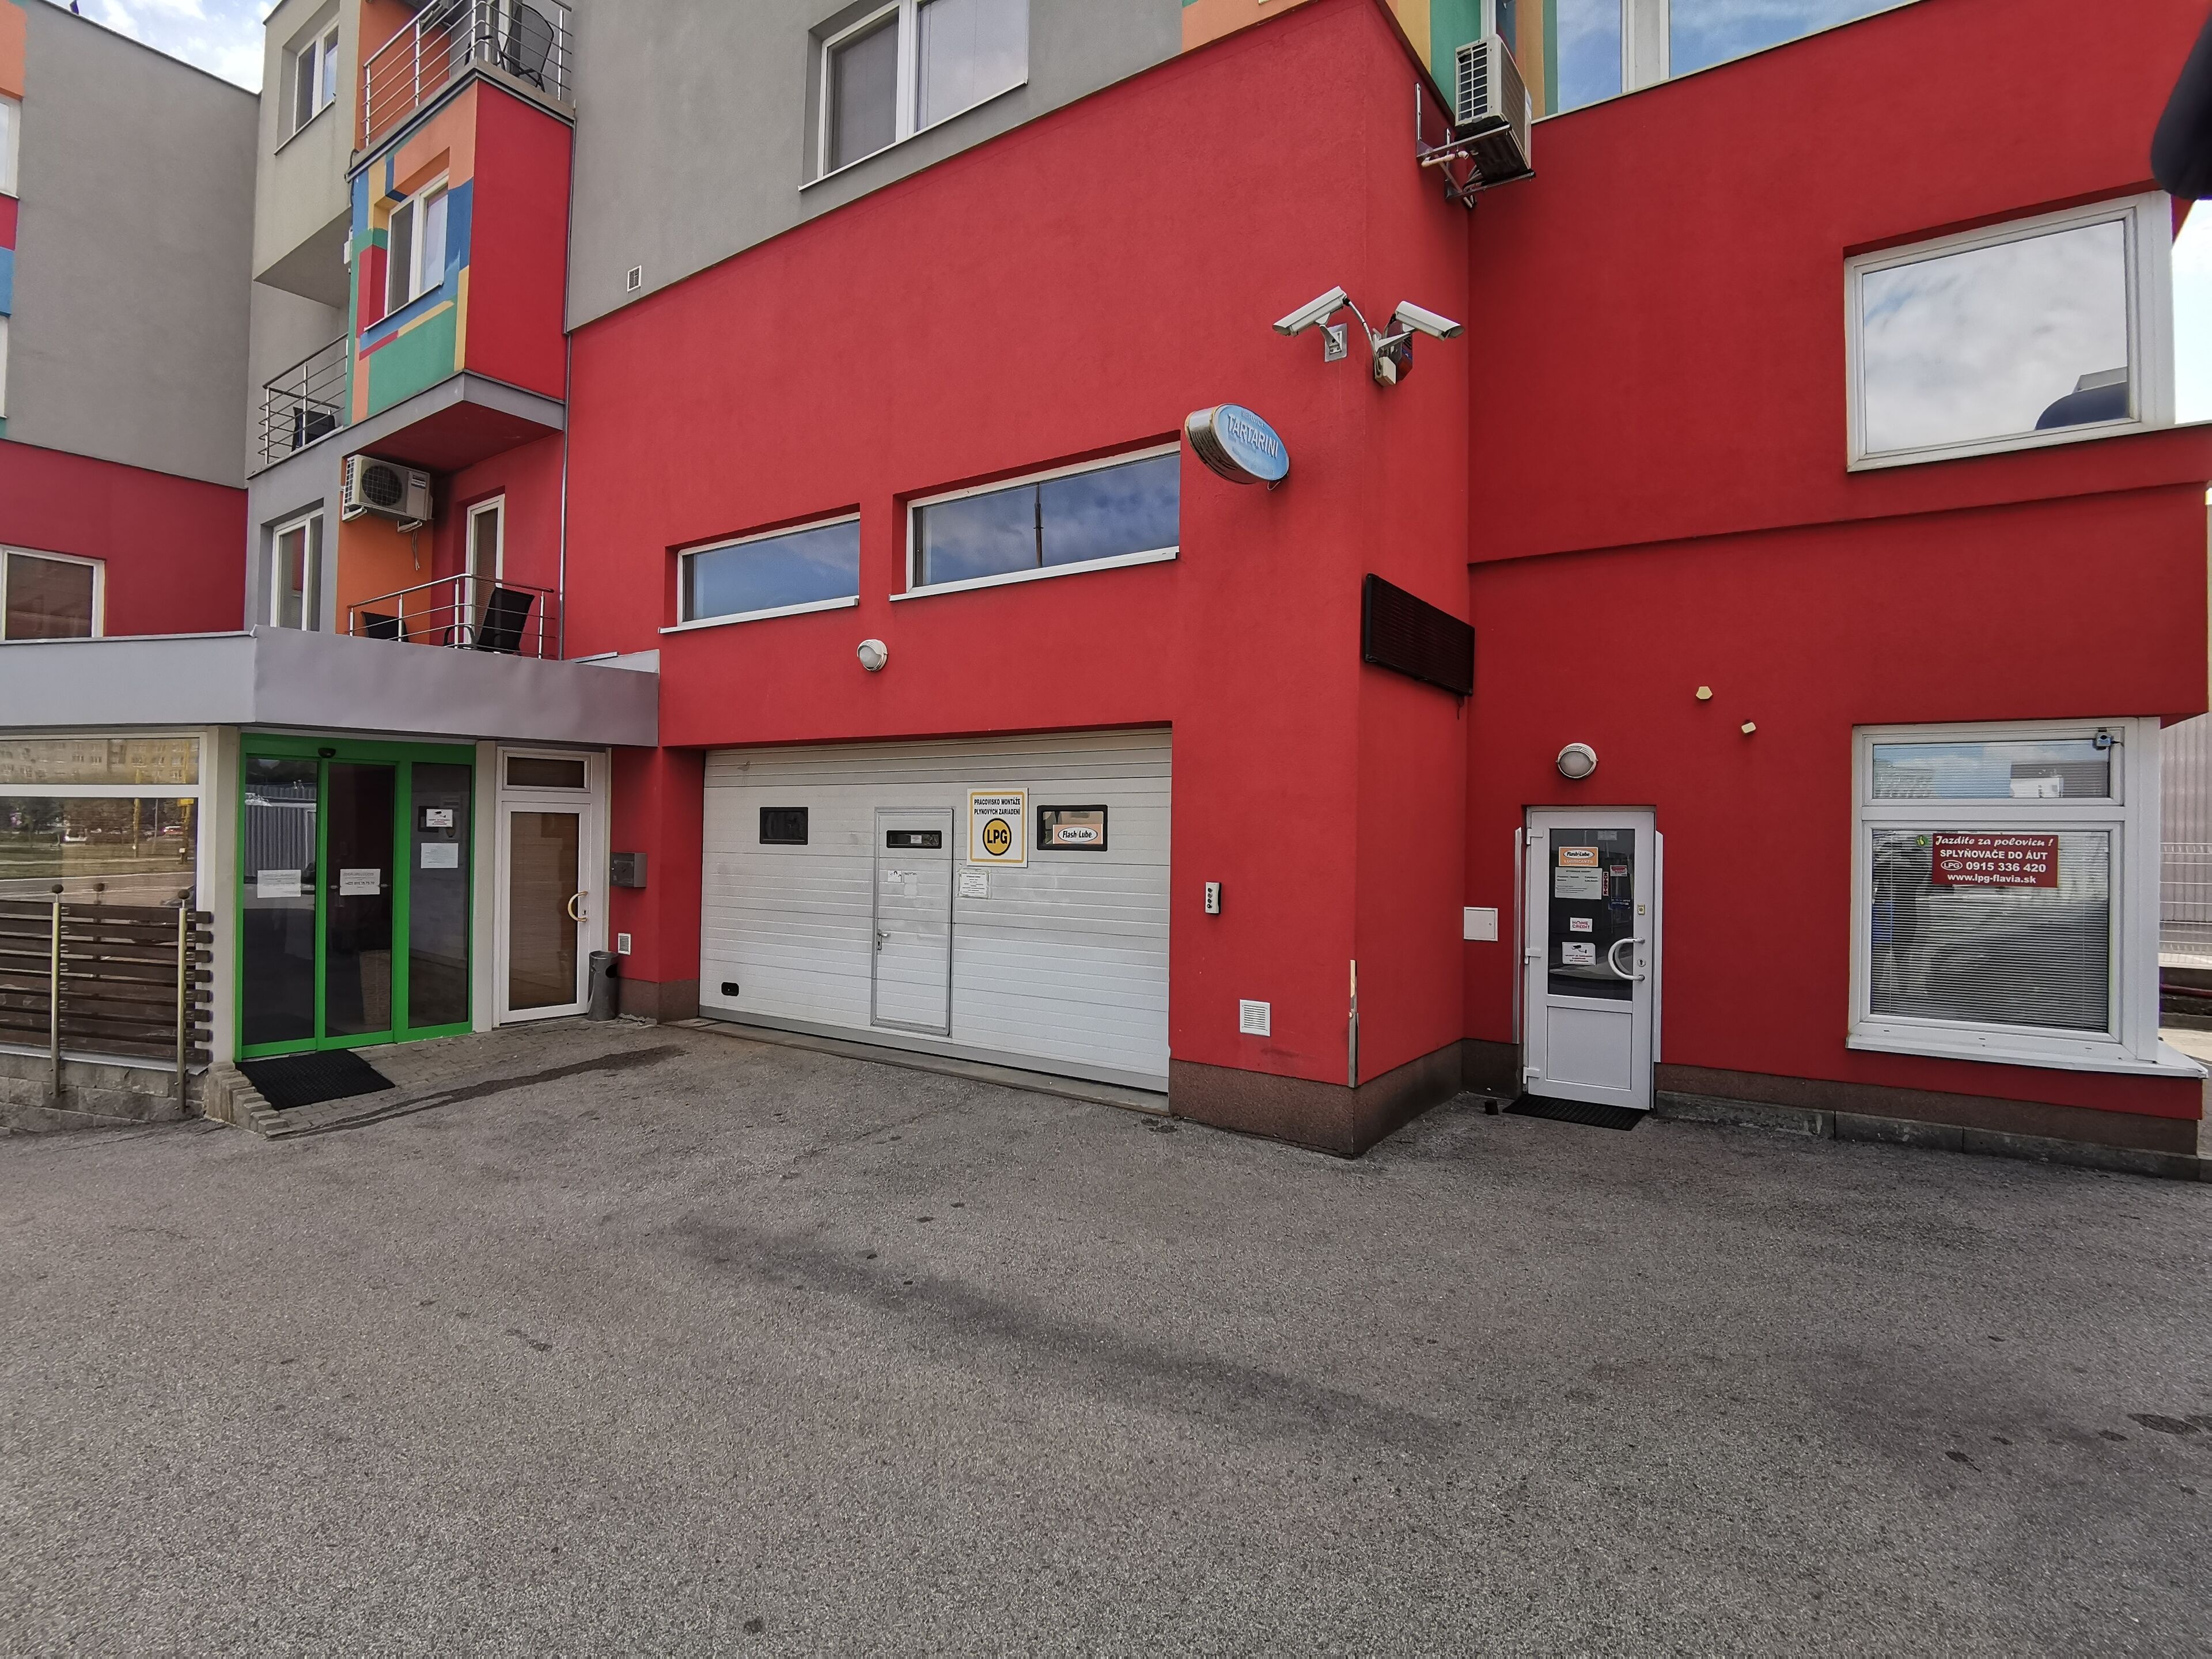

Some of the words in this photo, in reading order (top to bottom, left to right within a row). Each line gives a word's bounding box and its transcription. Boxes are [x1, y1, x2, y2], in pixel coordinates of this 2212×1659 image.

[1227, 413, 1279, 459] TARTARINI
[1001, 797, 1021, 805] MONTÁŽE
[974, 807, 998, 815] PLYNOVÝCH
[998, 807, 1021, 815] ZARIADENÍ
[987, 829, 1007, 844] LPG
[1062, 830, 1077, 838] Flash
[1078, 830, 1092, 838] Lube
[1936, 835, 1975, 846] Jazdite
[1994, 838, 2046, 847] polovicu
[1940, 849, 2005, 859] SPLYŇOVAČE
[1965, 861, 1994, 870] 0915
[1998, 863, 2020, 871] 336
[2023, 863, 2046, 872] 420
[1947, 873, 2036, 884] www.lpg-flavia.sk
